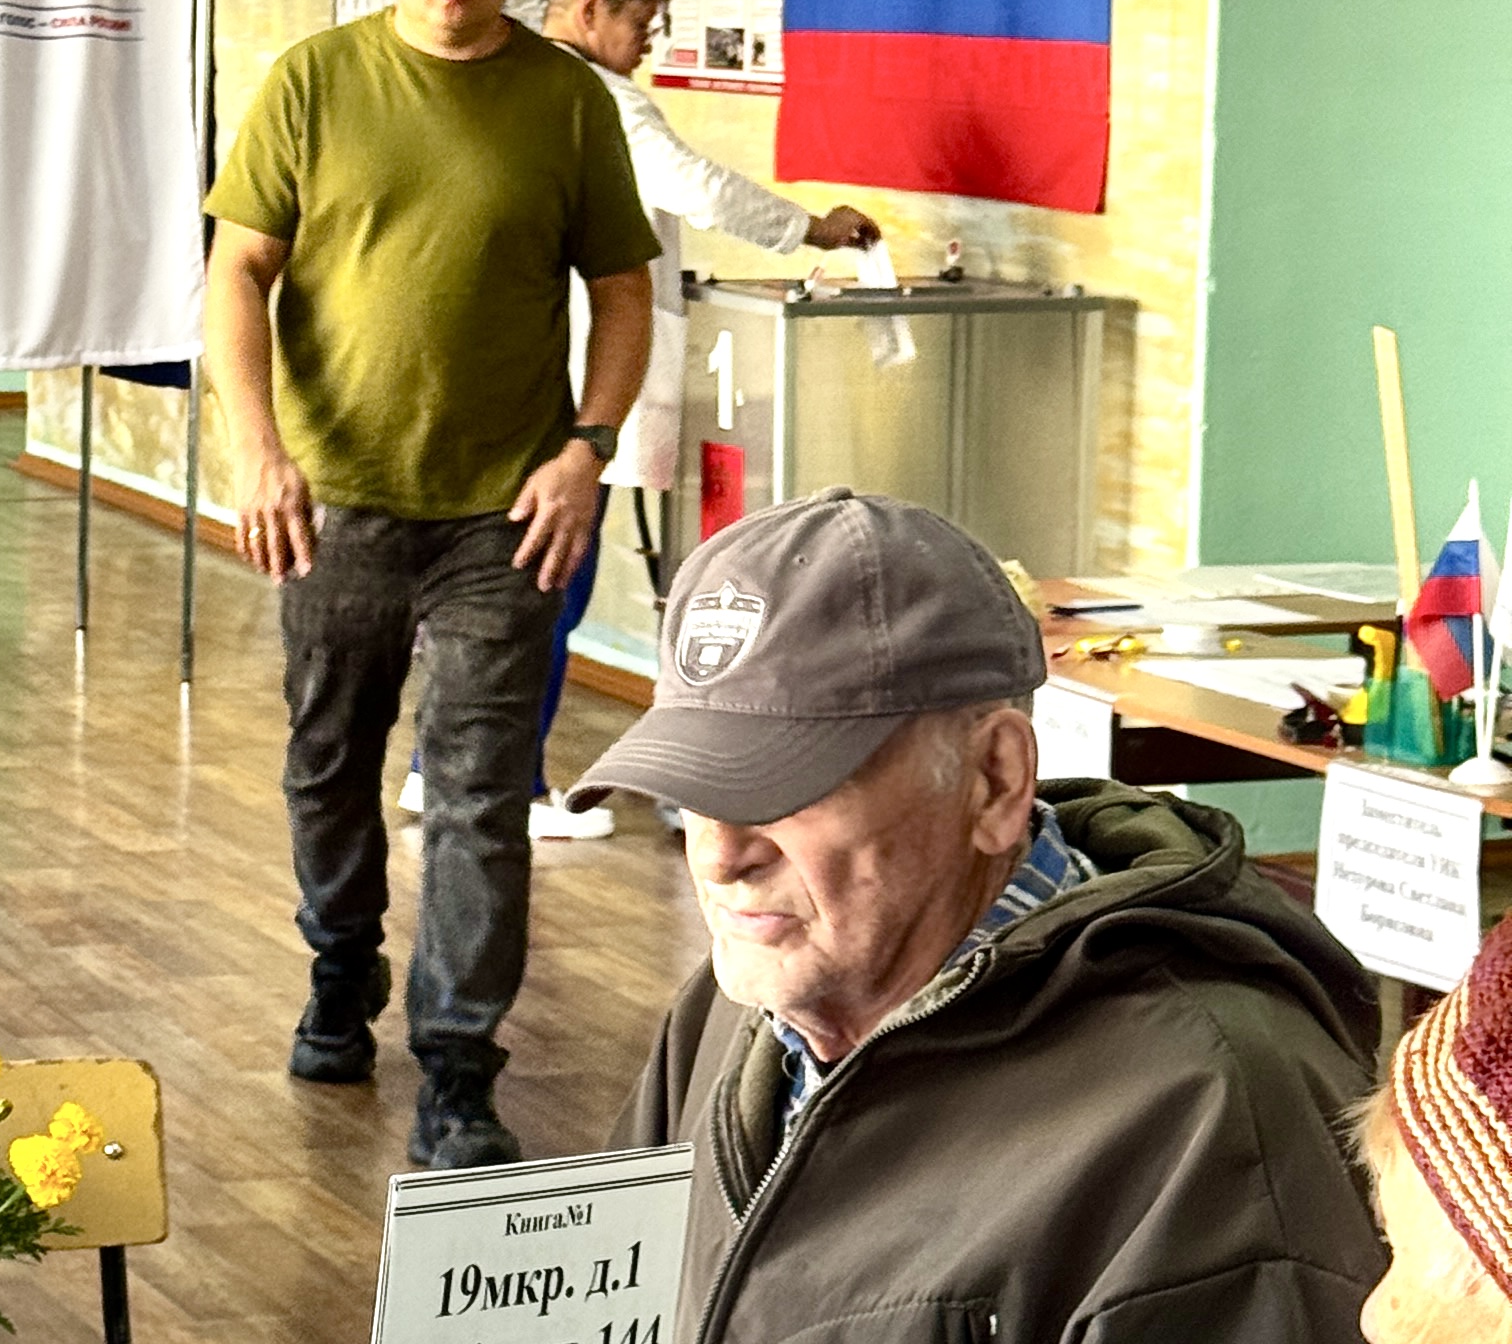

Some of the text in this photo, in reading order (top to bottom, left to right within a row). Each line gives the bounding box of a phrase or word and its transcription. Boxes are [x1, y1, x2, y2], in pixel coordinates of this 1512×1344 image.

[707, 329, 734, 431] 1
[434, 1241, 643, 1318] 19мкр. д.1
